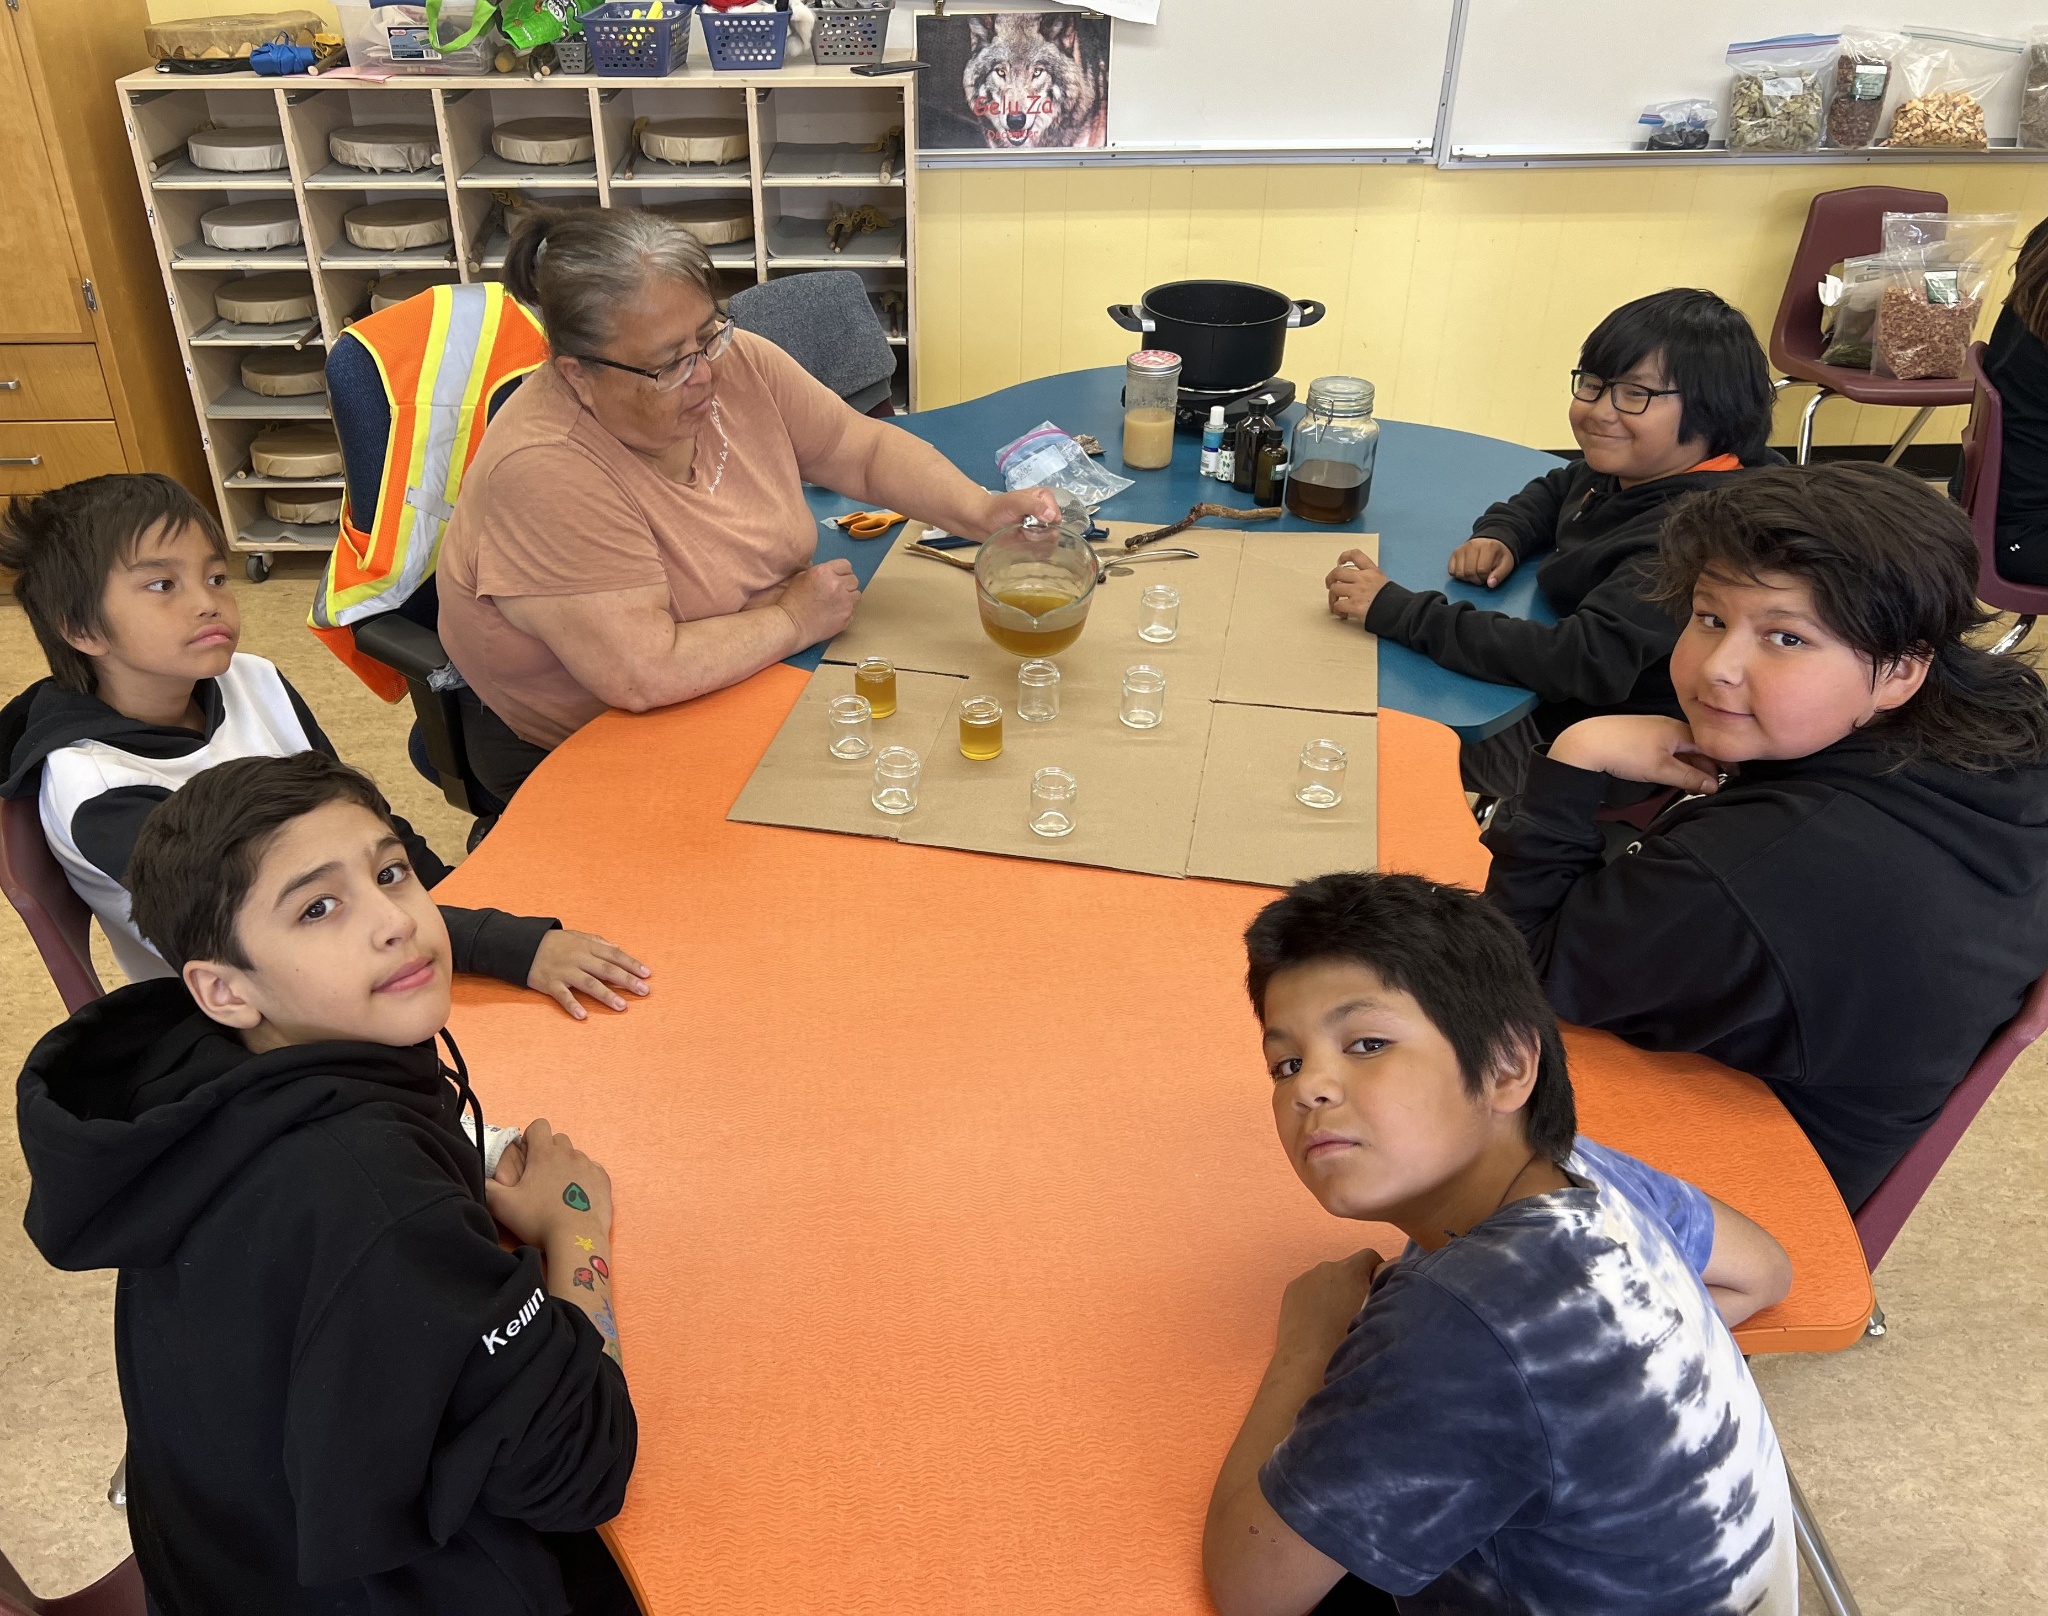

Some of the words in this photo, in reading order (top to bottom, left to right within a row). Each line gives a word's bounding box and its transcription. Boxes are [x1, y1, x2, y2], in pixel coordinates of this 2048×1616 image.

[973, 95, 1019, 117] Gelu
[1026, 94, 1054, 115] Za
[481, 1287, 545, 1356] Kellin
